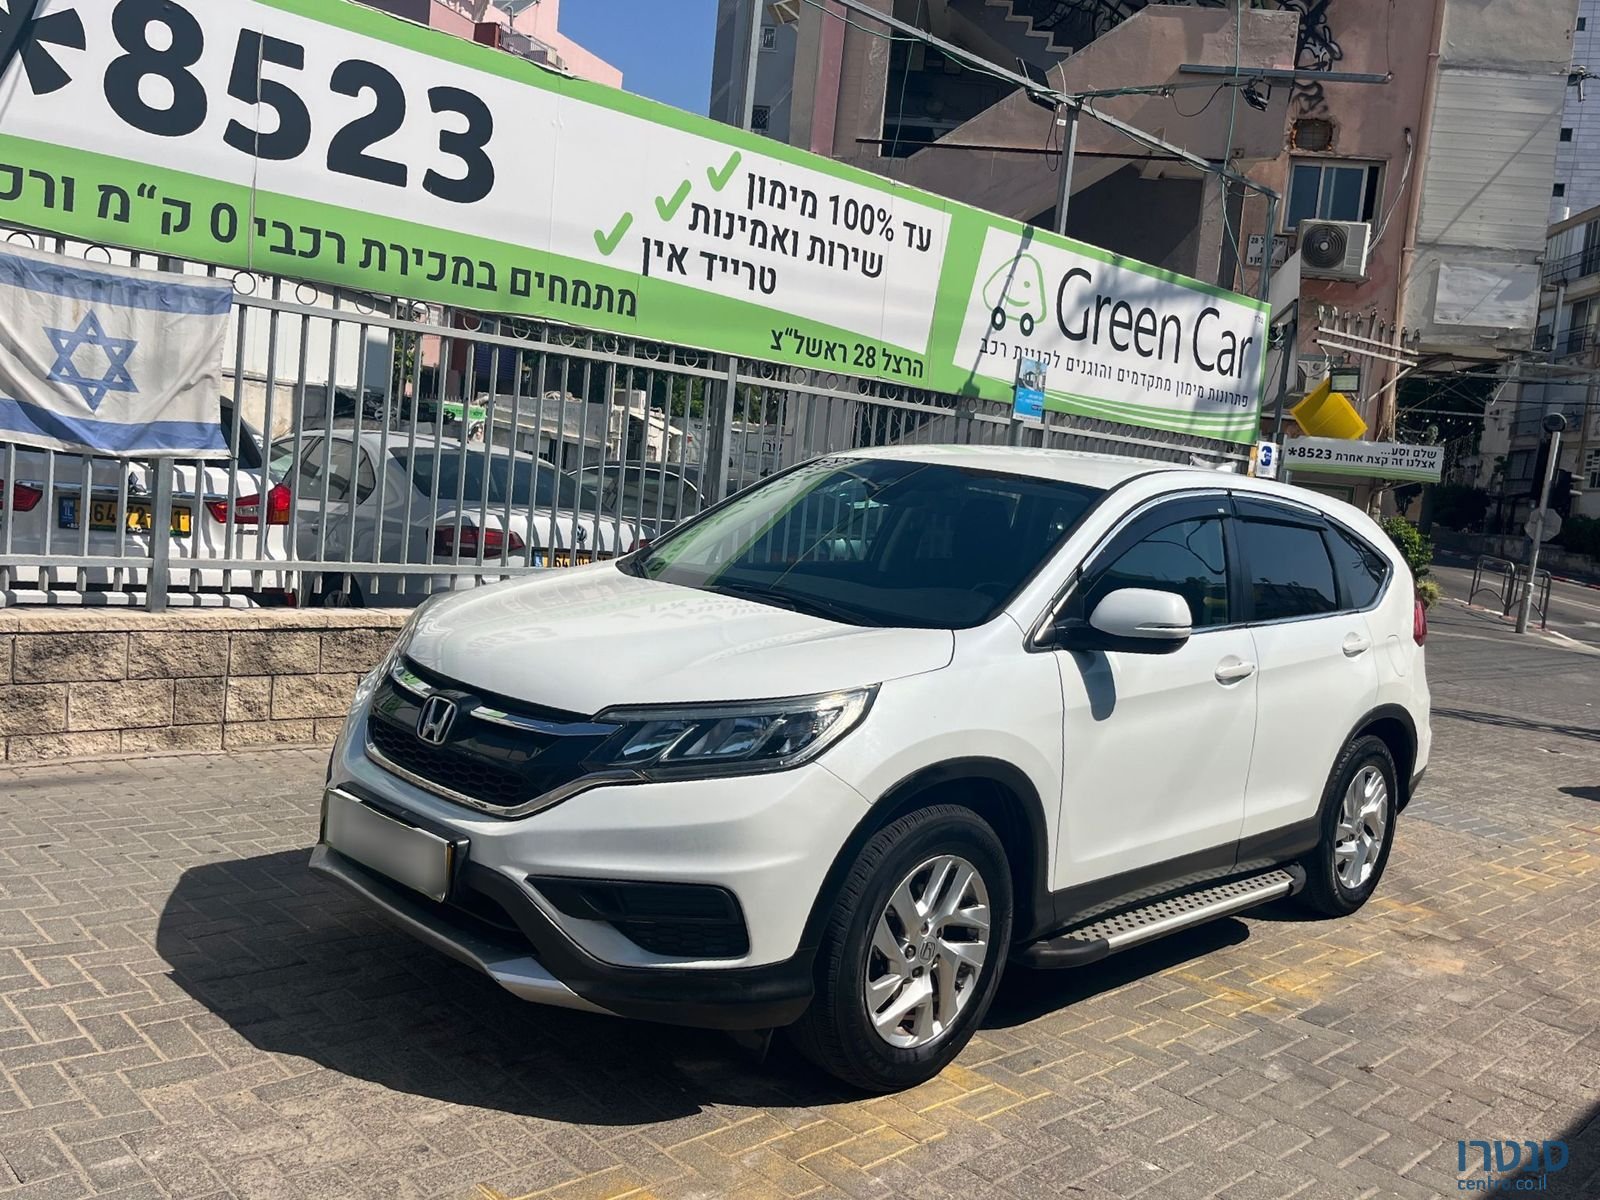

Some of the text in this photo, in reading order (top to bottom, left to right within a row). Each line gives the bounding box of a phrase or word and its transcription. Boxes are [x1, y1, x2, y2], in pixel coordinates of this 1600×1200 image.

[210, 203, 238, 243] 0
[748, 172, 932, 252] עד 100% מימון
[254, 217, 346, 262] רכבי
[688, 202, 883, 278] שירות ואמינות
[359, 238, 498, 293] במכירת
[642, 237, 777, 295] טרייד אין
[510, 268, 637, 317] מתמחים
[1055, 267, 1253, 380] Green Car
[770, 327, 924, 378] הרצל 28 ראשל"צ
[979, 338, 1007, 358] רכב
[1066, 357, 1112, 380] והוגנים
[1117, 368, 1171, 391] מתקדמים
[1175, 380, 1204, 398] מימון
[1207, 387, 1249, 407] פתרונות
[1335, 452, 1436, 469] אצלנו זה קצת אחרת
[1413, 447, 1437, 459] שלם
